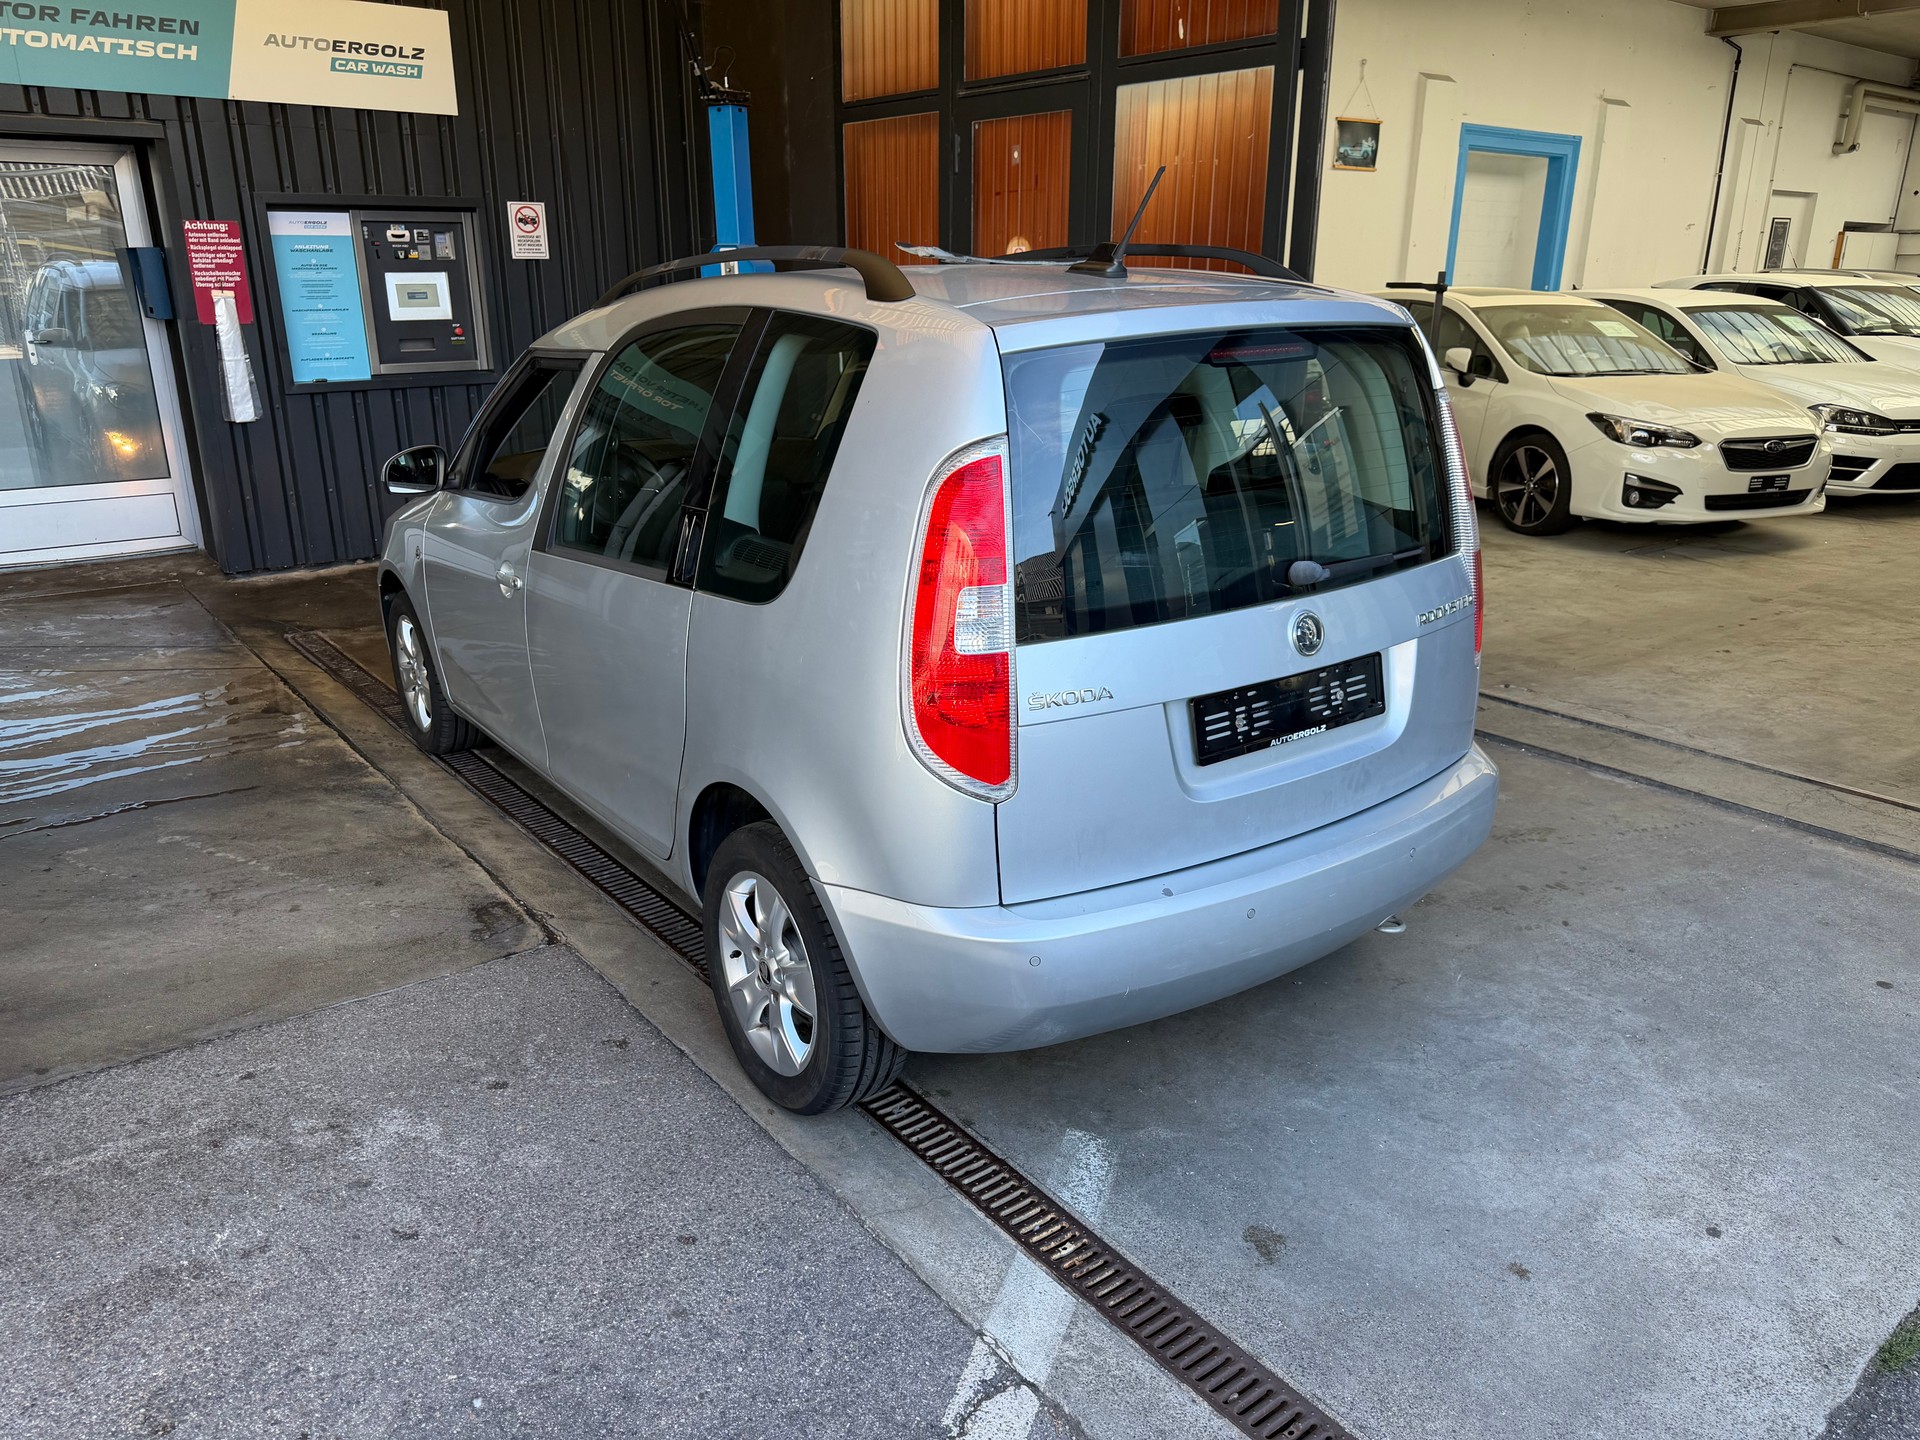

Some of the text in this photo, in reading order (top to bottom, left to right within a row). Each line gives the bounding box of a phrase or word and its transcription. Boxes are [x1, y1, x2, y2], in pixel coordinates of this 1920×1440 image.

[0, 0, 200, 36] TOR FAHREN
[0, 27, 198, 61] TOMATISCH
[263, 33, 425, 60] AUTOERGOLZ
[334, 60, 419, 77] CAR WASH
[184, 221, 228, 232] Achtung:
[1027, 686, 1114, 711] ŠKODA
[1270, 724, 1327, 747] AUTOERGOLZ
